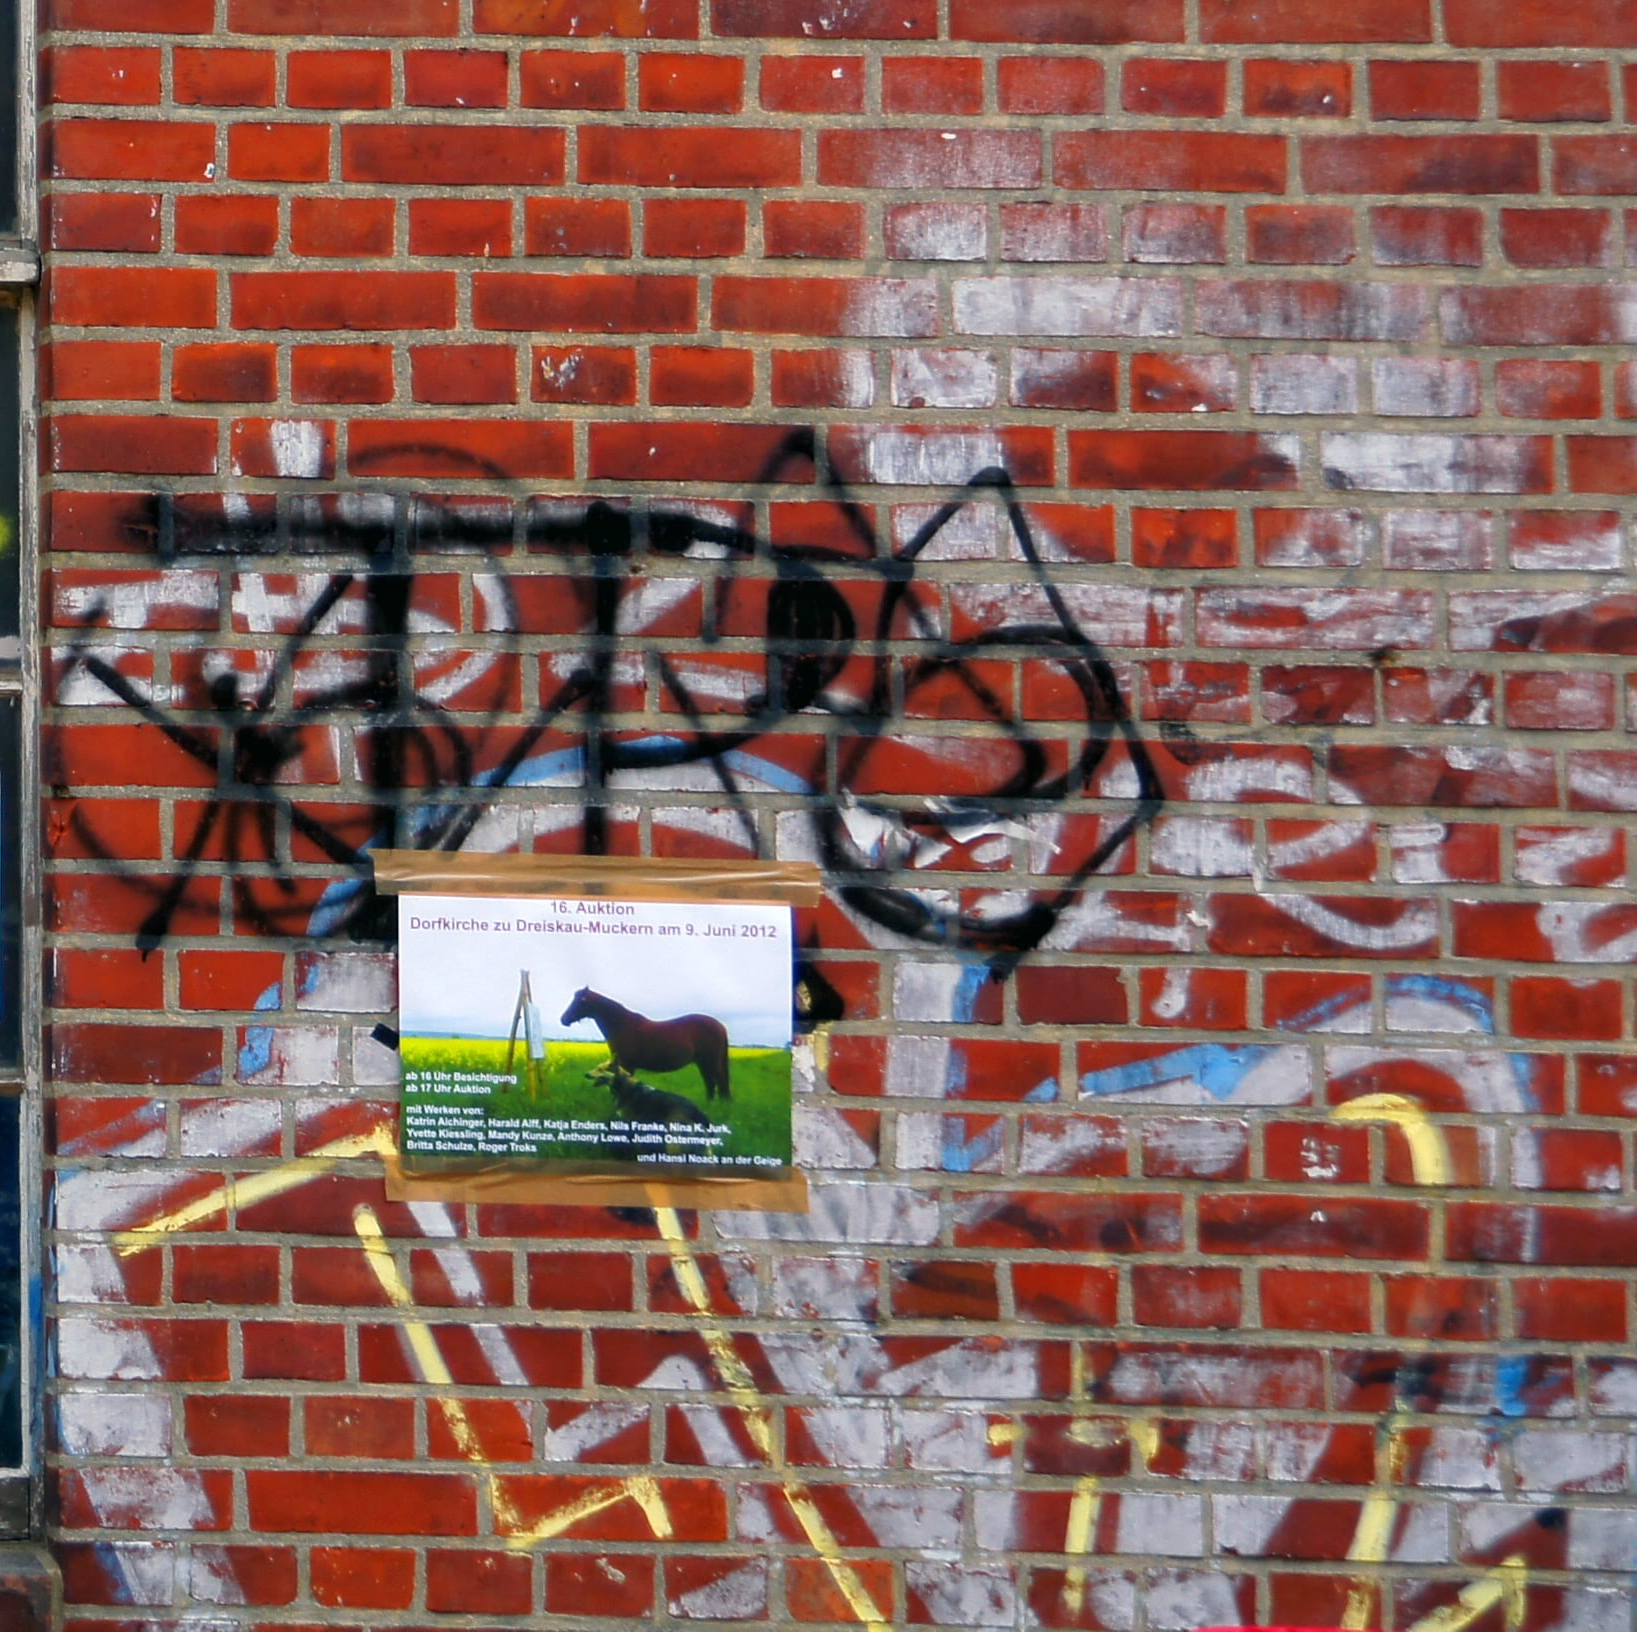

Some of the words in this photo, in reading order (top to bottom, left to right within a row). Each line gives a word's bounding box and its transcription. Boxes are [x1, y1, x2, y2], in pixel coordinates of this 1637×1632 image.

[550, 901, 572, 914] 16.
[576, 901, 635, 915] Auktion
[410, 916, 489, 931] Dorfkirche
[494, 920, 511, 932] zu
[516, 918, 653, 935] Dreiskau-Muckern
[658, 925, 681, 935] am
[685, 923, 699, 936] 9.
[703, 923, 736, 937] Juni
[741, 925, 777, 938] 2012
[405, 1072, 418, 1081] ab
[433, 1072, 451, 1081] Uhr
[453, 1072, 517, 1084] Besichtigung
[405, 1085, 418, 1093] ab
[420, 1085, 432, 1093] 17
[433, 1085, 451, 1093] Uhr
[453, 1085, 491, 1094] Auktion
[406, 1105, 422, 1114] mit
[424, 1106, 461, 1115] Werken
[463, 1107, 484, 1115] von:
[406, 1117, 436, 1126] Katrin
[488, 1118, 520, 1128] Harald
[543, 1119, 569, 1130] Katja
[571, 1120, 608, 1131] Enders,
[610, 1121, 629, 1131] Nils
[631, 1121, 667, 1132] Franke,
[669, 1122, 692, 1132] Nina
[407, 1128, 437, 1138] Yvette
[488, 1130, 520, 1141] Mandy
[522, 1131, 556, 1142] Kunze,
[558, 1131, 598, 1144] Anthony
[632, 1133, 663, 1143] Judith
[407, 1141, 433, 1150] Britta
[435, 1141, 476, 1151] Schulze,
[478, 1142, 507, 1153] Roger
[636, 1153, 656, 1162] und
[688, 1154, 719, 1164] Noack
[721, 1156, 733, 1164] an
[735, 1155, 752, 1165] der
[753, 1156, 782, 1166] Geige
